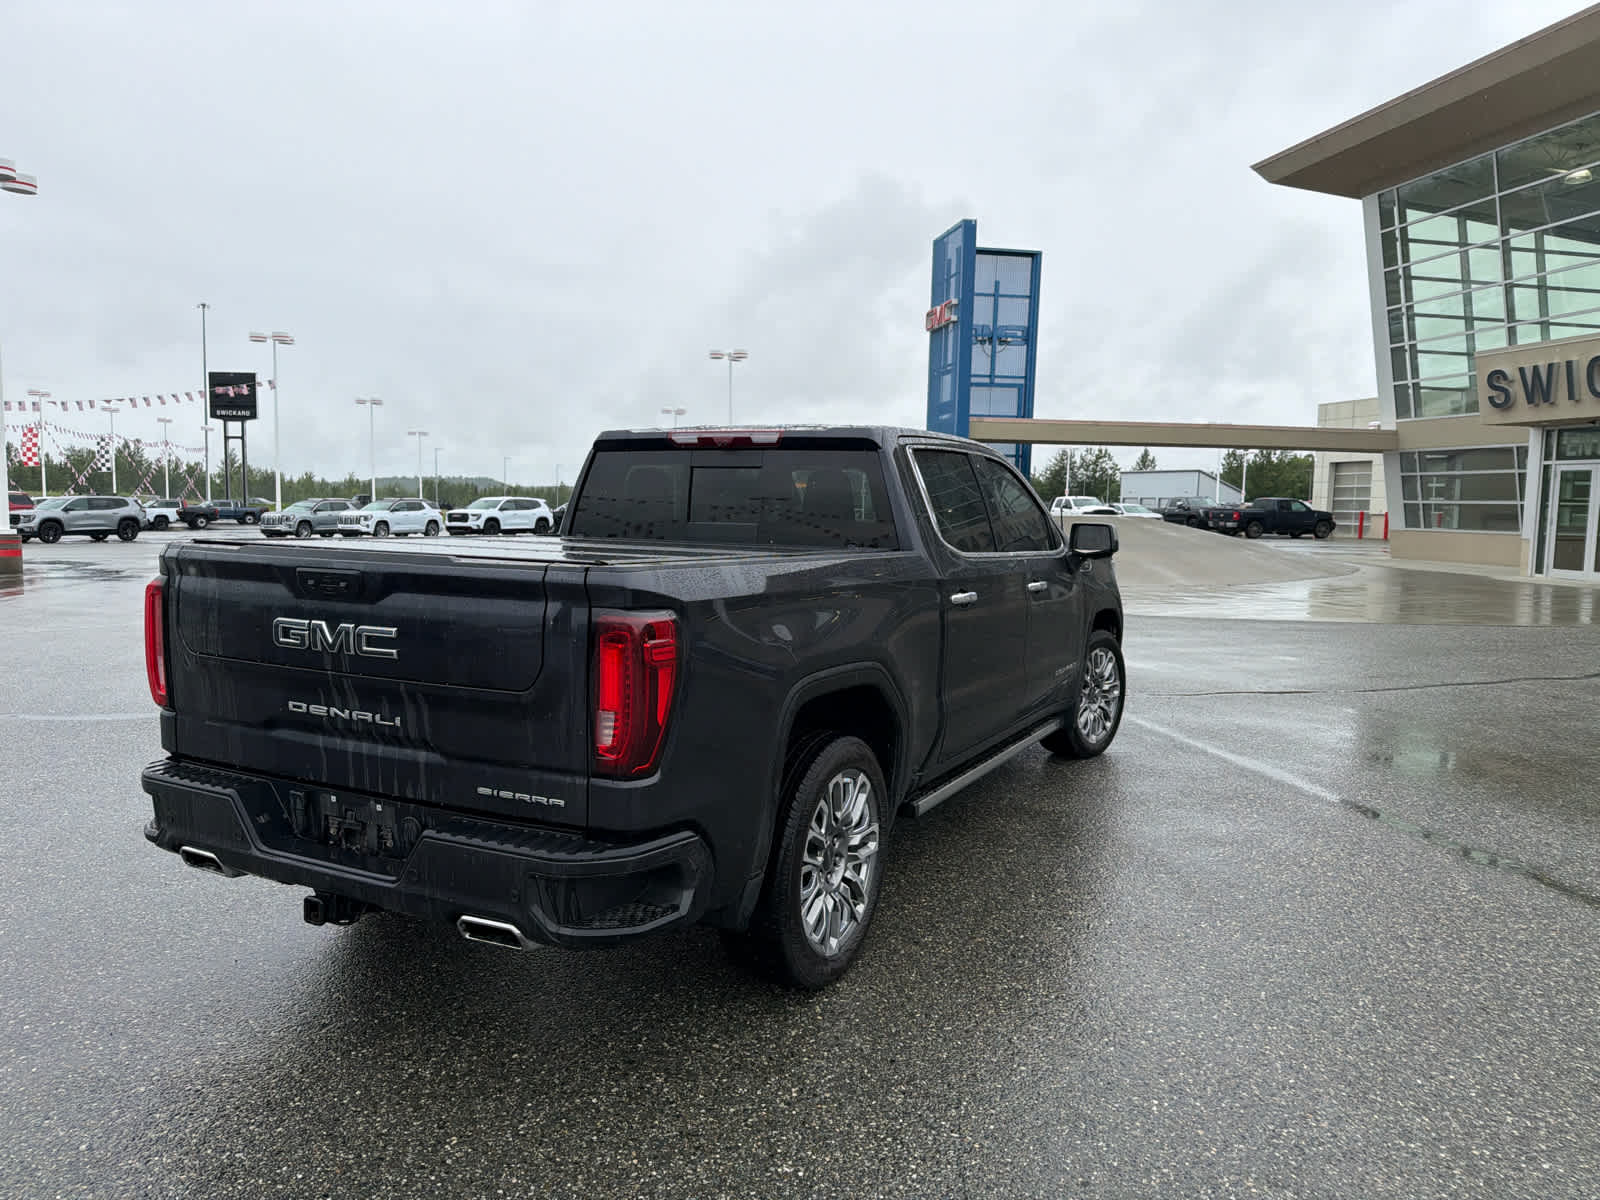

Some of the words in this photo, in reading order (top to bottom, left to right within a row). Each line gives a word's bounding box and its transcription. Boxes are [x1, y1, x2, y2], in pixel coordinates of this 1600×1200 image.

[926, 299, 958, 331] GMC
[272, 616, 398, 660] GMC
[287, 700, 402, 727] DENALI
[476, 786, 565, 808] SIERRA
